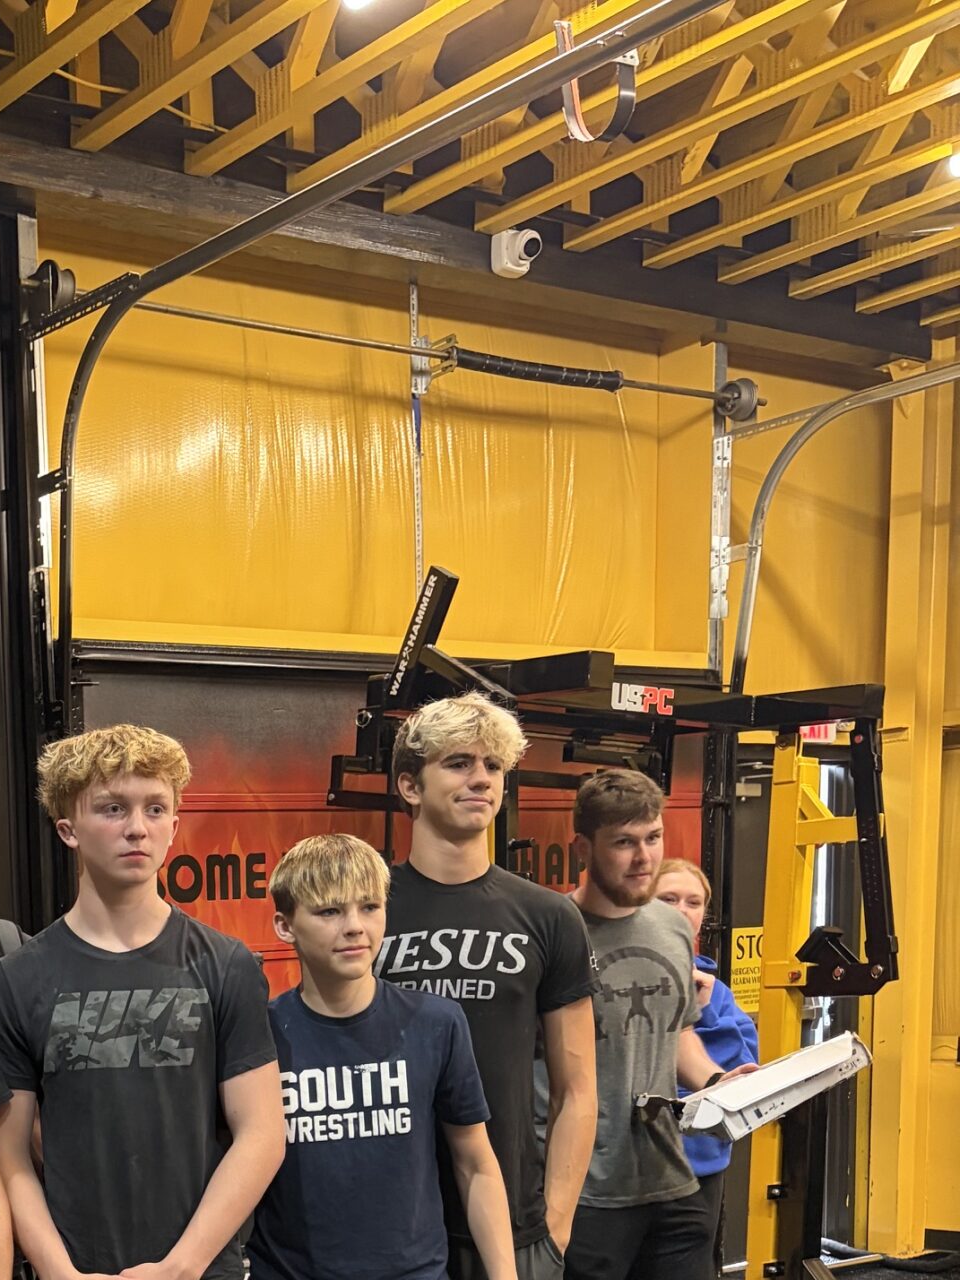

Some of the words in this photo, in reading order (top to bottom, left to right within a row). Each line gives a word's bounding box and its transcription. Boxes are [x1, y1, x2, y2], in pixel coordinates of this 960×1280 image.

[611, 682, 675, 715] USPC
[157, 853, 267, 904] OME
[373, 928, 529, 978] JESUS
[43, 987, 209, 1073] NIKE
[279, 1060, 409, 1115] SOUTH
